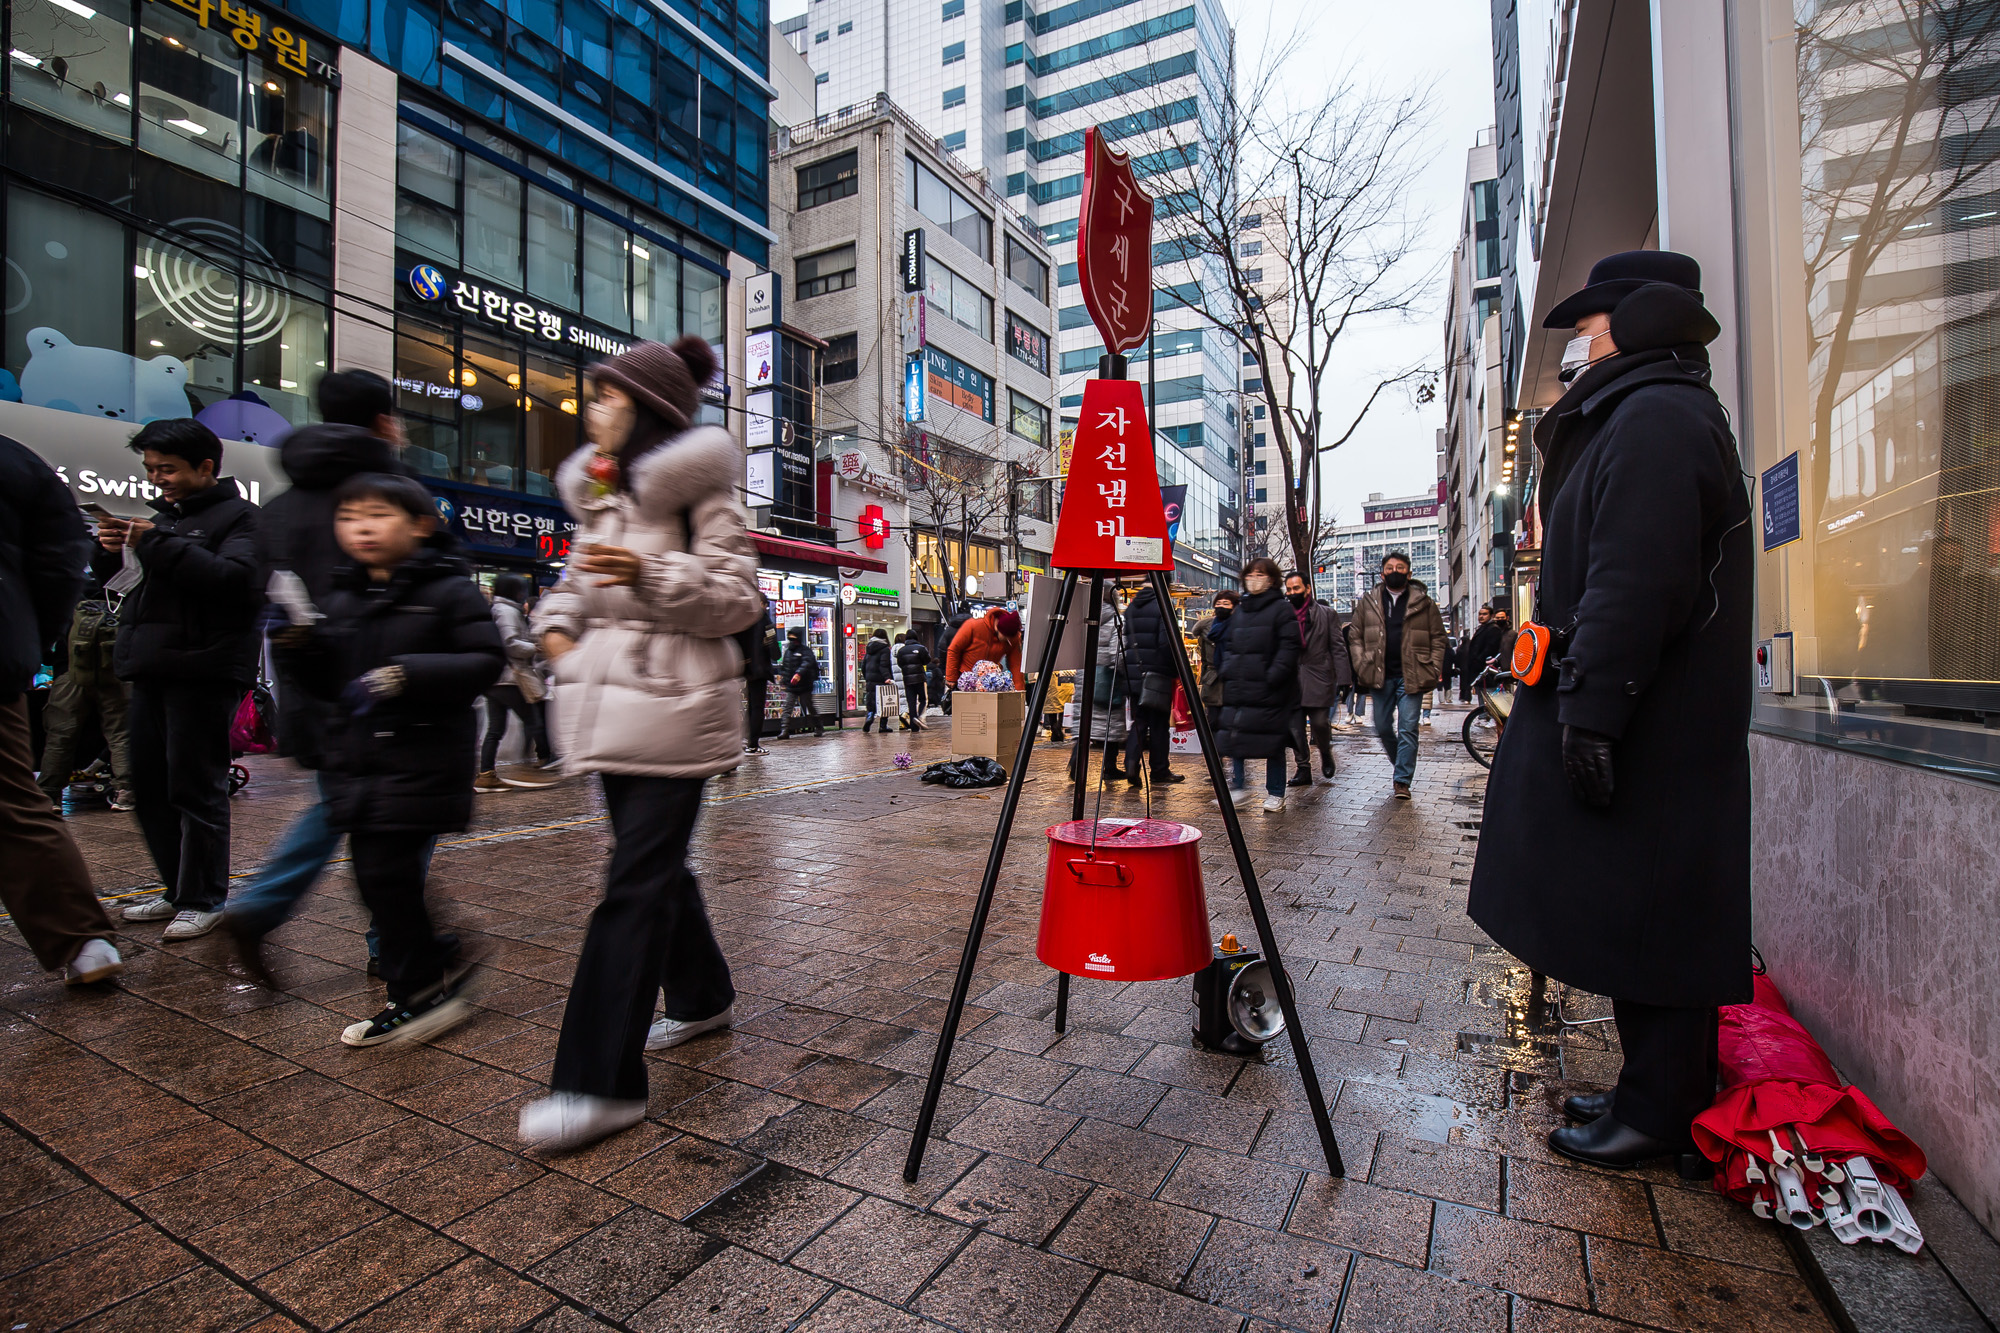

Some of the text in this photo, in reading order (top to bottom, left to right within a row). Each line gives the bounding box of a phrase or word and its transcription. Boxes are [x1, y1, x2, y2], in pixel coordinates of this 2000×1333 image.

[908, 232, 917, 286] TONYMOLY
[1109, 175, 1134, 331] 구세군
[452, 280, 562, 341] 신한은행
[748, 304, 770, 314] Shinhan
[924, 348, 948, 372] LINE
[910, 363, 919, 410] LINE
[929, 375, 943, 388] Skin
[930, 385, 943, 397] care
[841, 453, 860, 476] 藥
[1095, 406, 1131, 537] 자선냄비
[460, 505, 555, 538] 신한은행
[843, 589, 853, 601] 약
[775, 601, 795, 614] SIM
[1088, 952, 1111, 964] Fissler
